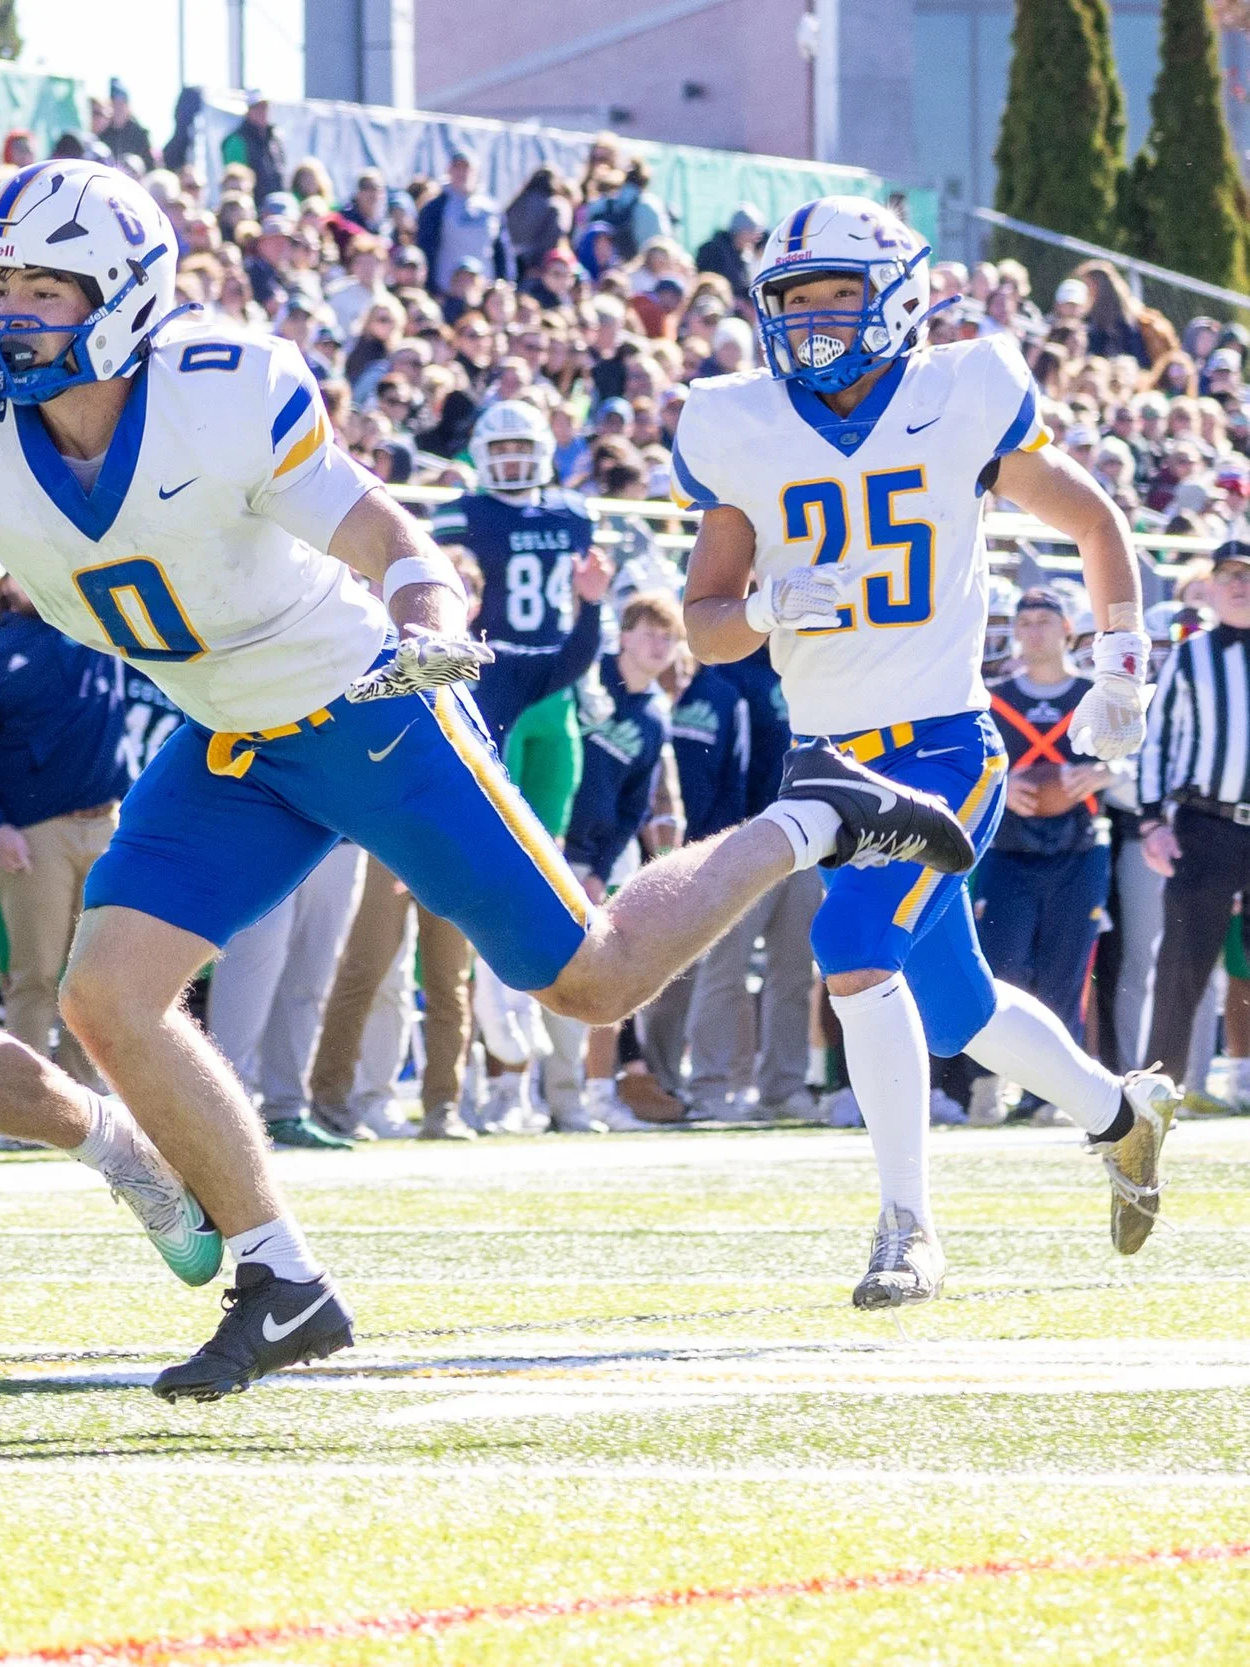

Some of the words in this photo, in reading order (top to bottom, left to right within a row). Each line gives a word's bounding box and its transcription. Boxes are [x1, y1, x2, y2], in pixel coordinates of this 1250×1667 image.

[179, 341, 245, 374] 0
[508, 529, 571, 552] GULLS
[778, 463, 937, 636] 25
[70, 555, 212, 663] 0
[505, 551, 575, 635] 84
